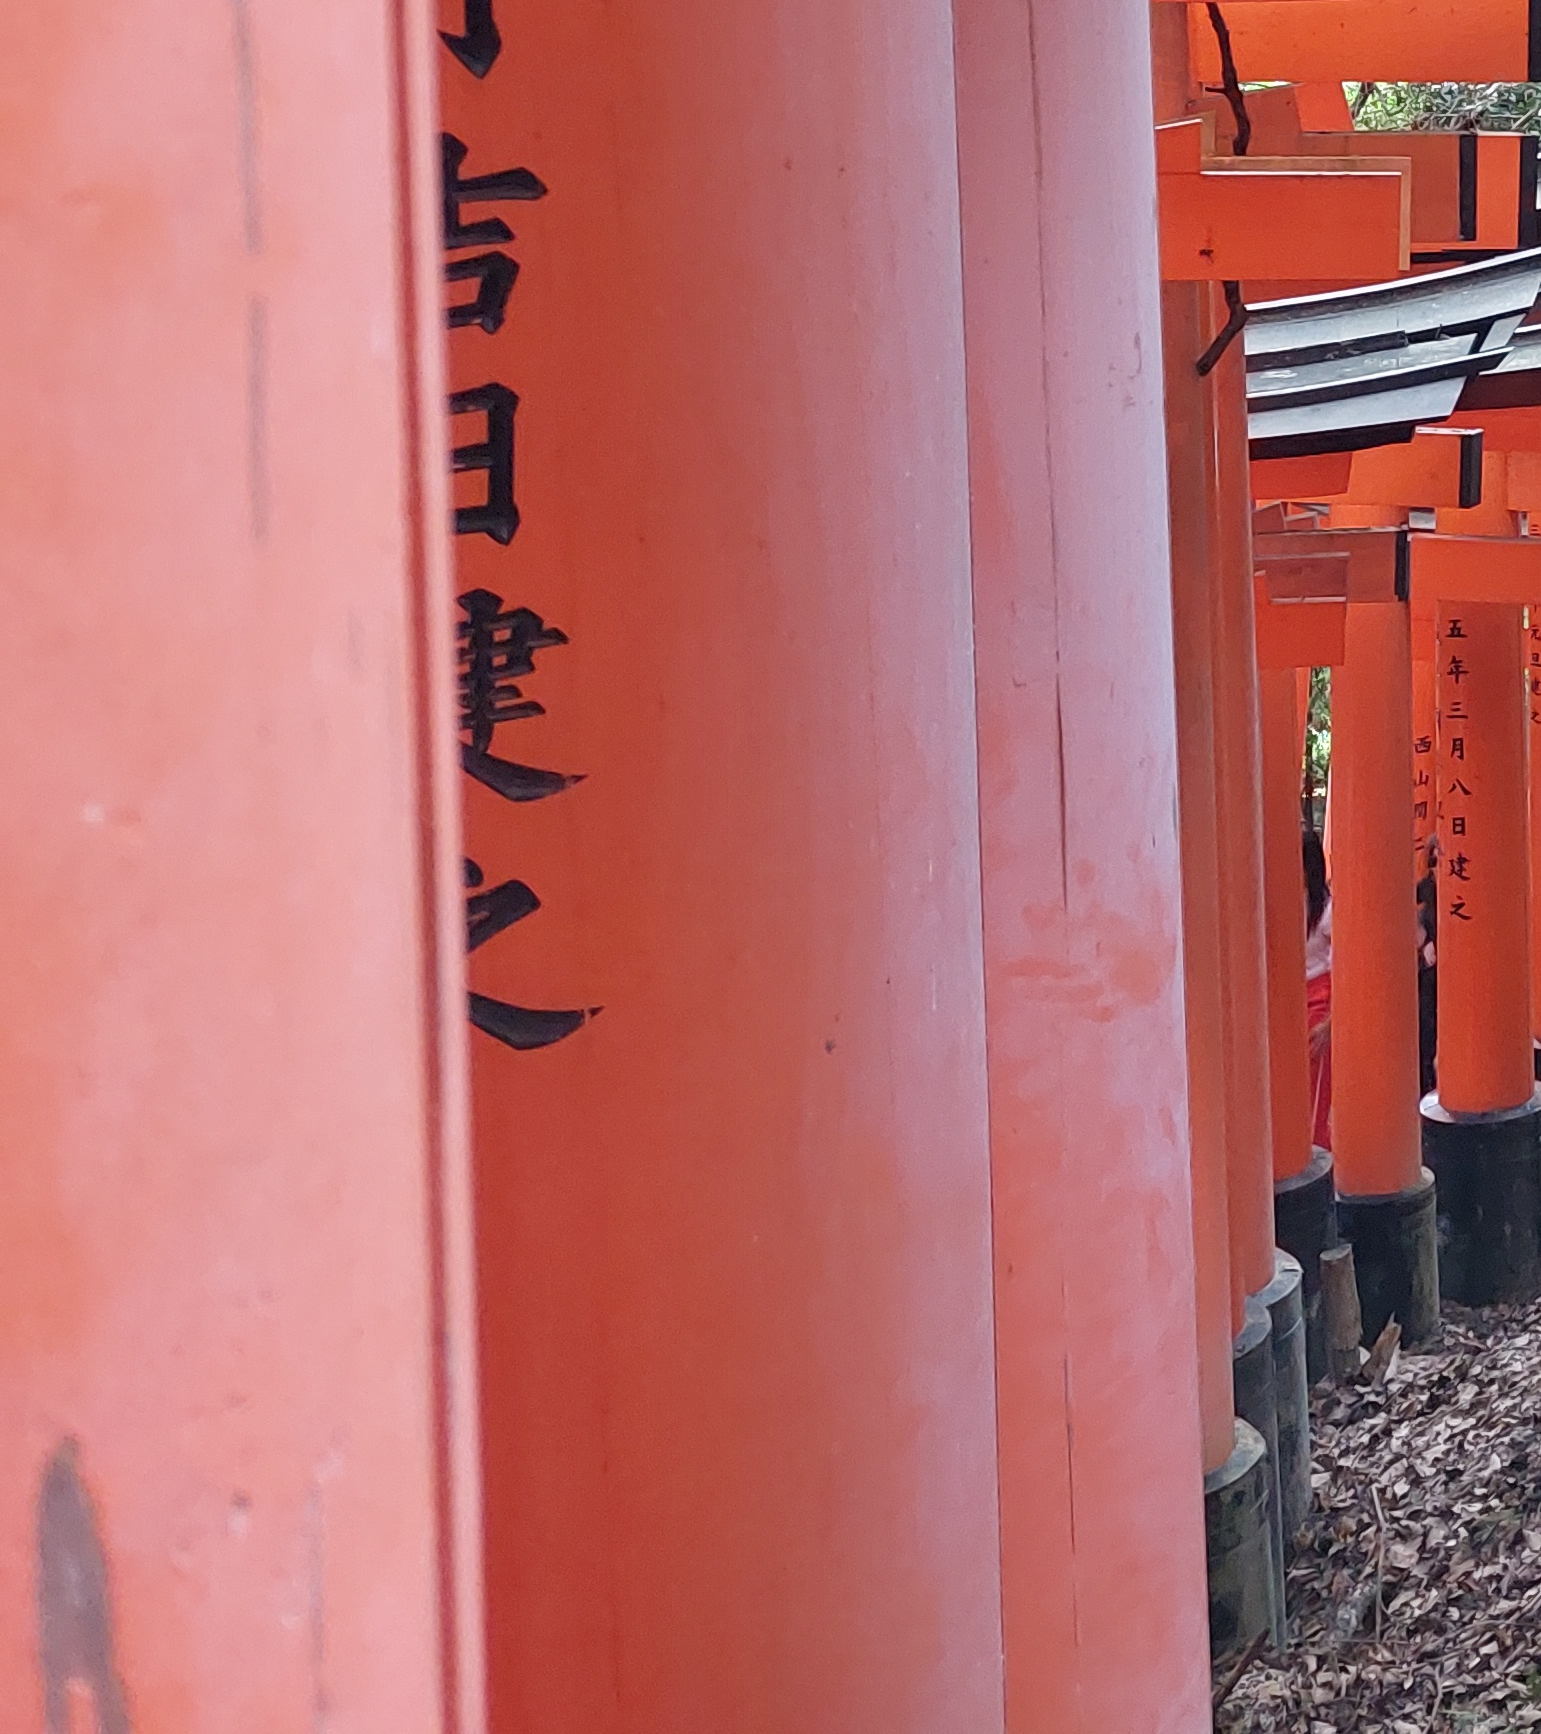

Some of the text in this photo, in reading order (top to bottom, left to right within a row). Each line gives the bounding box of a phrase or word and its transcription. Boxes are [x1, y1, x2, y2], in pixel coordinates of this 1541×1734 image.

[1445, 619, 1471, 921] 五年三月八日建之
